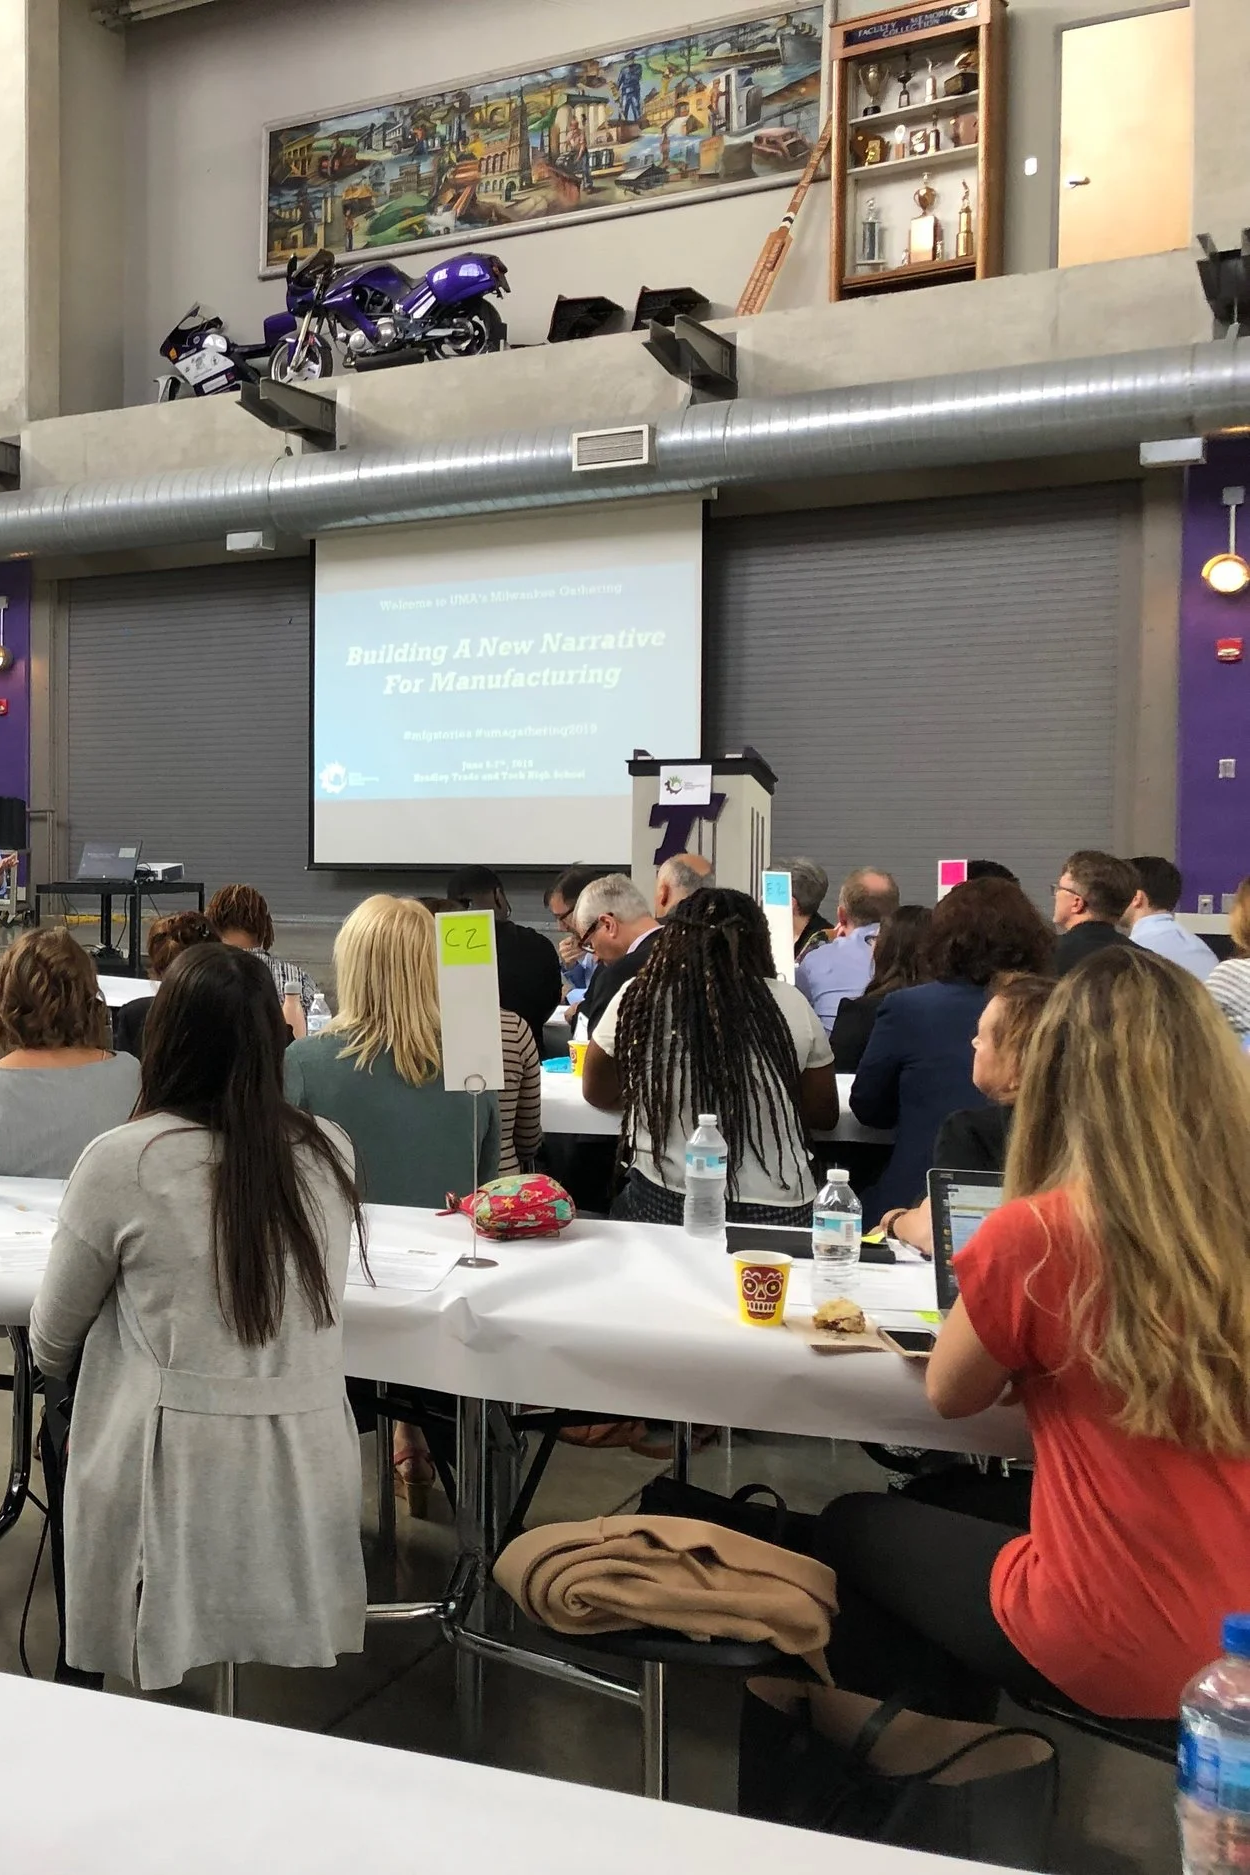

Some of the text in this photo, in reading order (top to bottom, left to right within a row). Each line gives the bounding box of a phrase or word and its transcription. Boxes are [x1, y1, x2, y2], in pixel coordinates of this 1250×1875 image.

[858, 21, 897, 38] FACULTY
[380, 598, 432, 612] Welcome
[435, 597, 447, 608] to
[450, 592, 488, 606] UMA's
[559, 583, 623, 598] Gathering
[346, 626, 667, 667] Building A New Narrative
[383, 664, 622, 695] For Manufacturing
